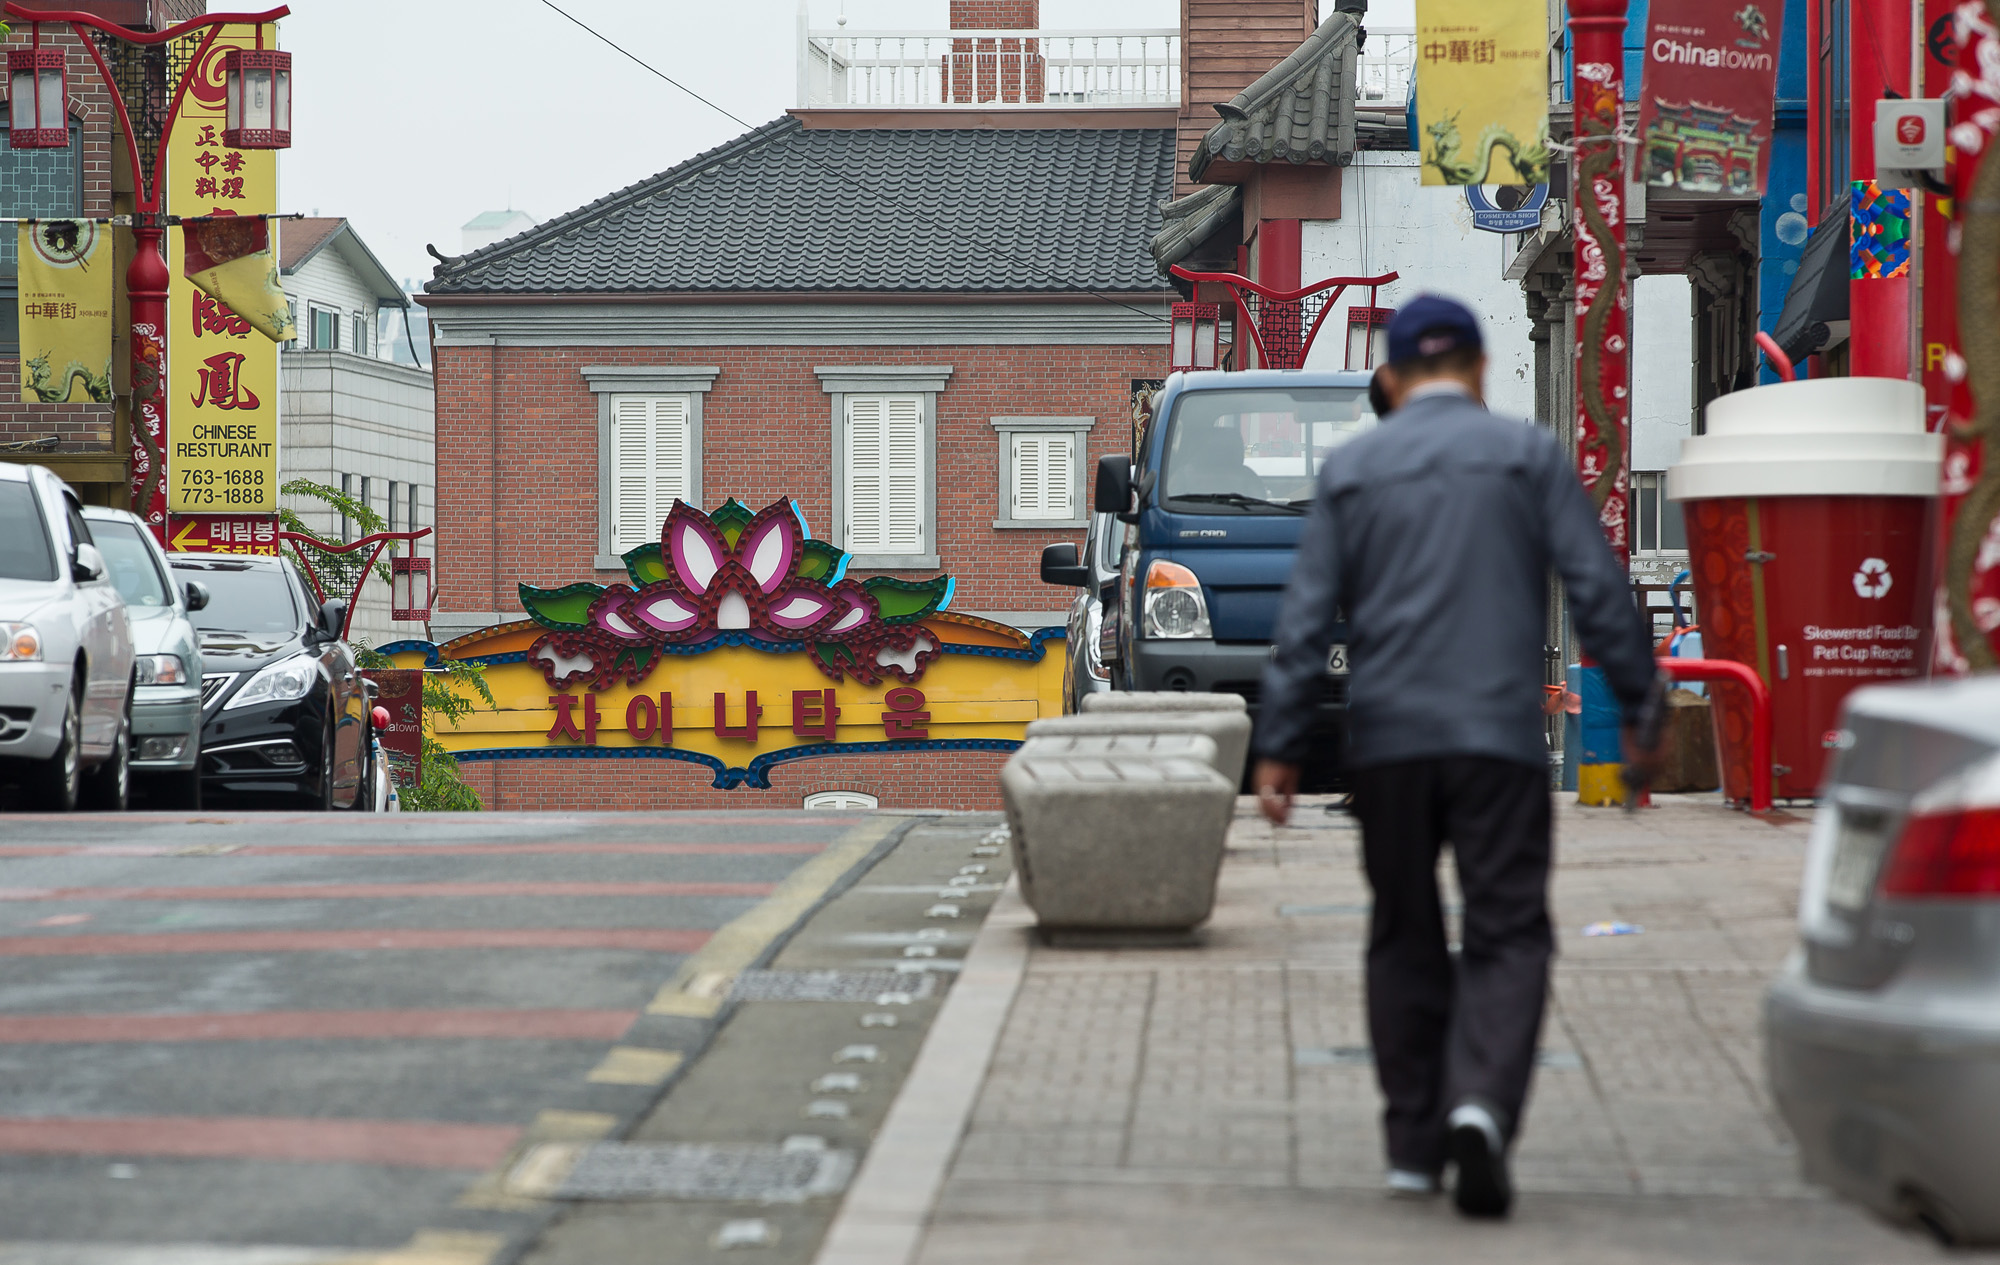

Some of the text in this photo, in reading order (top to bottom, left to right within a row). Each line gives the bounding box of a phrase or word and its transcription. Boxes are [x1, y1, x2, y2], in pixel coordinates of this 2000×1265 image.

[1423, 40, 1496, 65] 中華街
[1652, 38, 1773, 71] Chinatown
[195, 124, 227, 147] 正
[1478, 212, 1517, 220] COSMETICS
[25, 302, 77, 319] 中華街
[192, 424, 257, 440] CHINESE
[176, 442, 272, 458] RESTURANT
[181, 469, 264, 486] 763-1688
[181, 488, 264, 504] 773-1888
[210, 521, 276, 542] 태림봉
[1803, 625, 1874, 641] Skewered
[1813, 645, 1914, 663] Pet Cup Recycle
[545, 687, 932, 746] 차이나타운
[384, 722, 420, 733] atown
